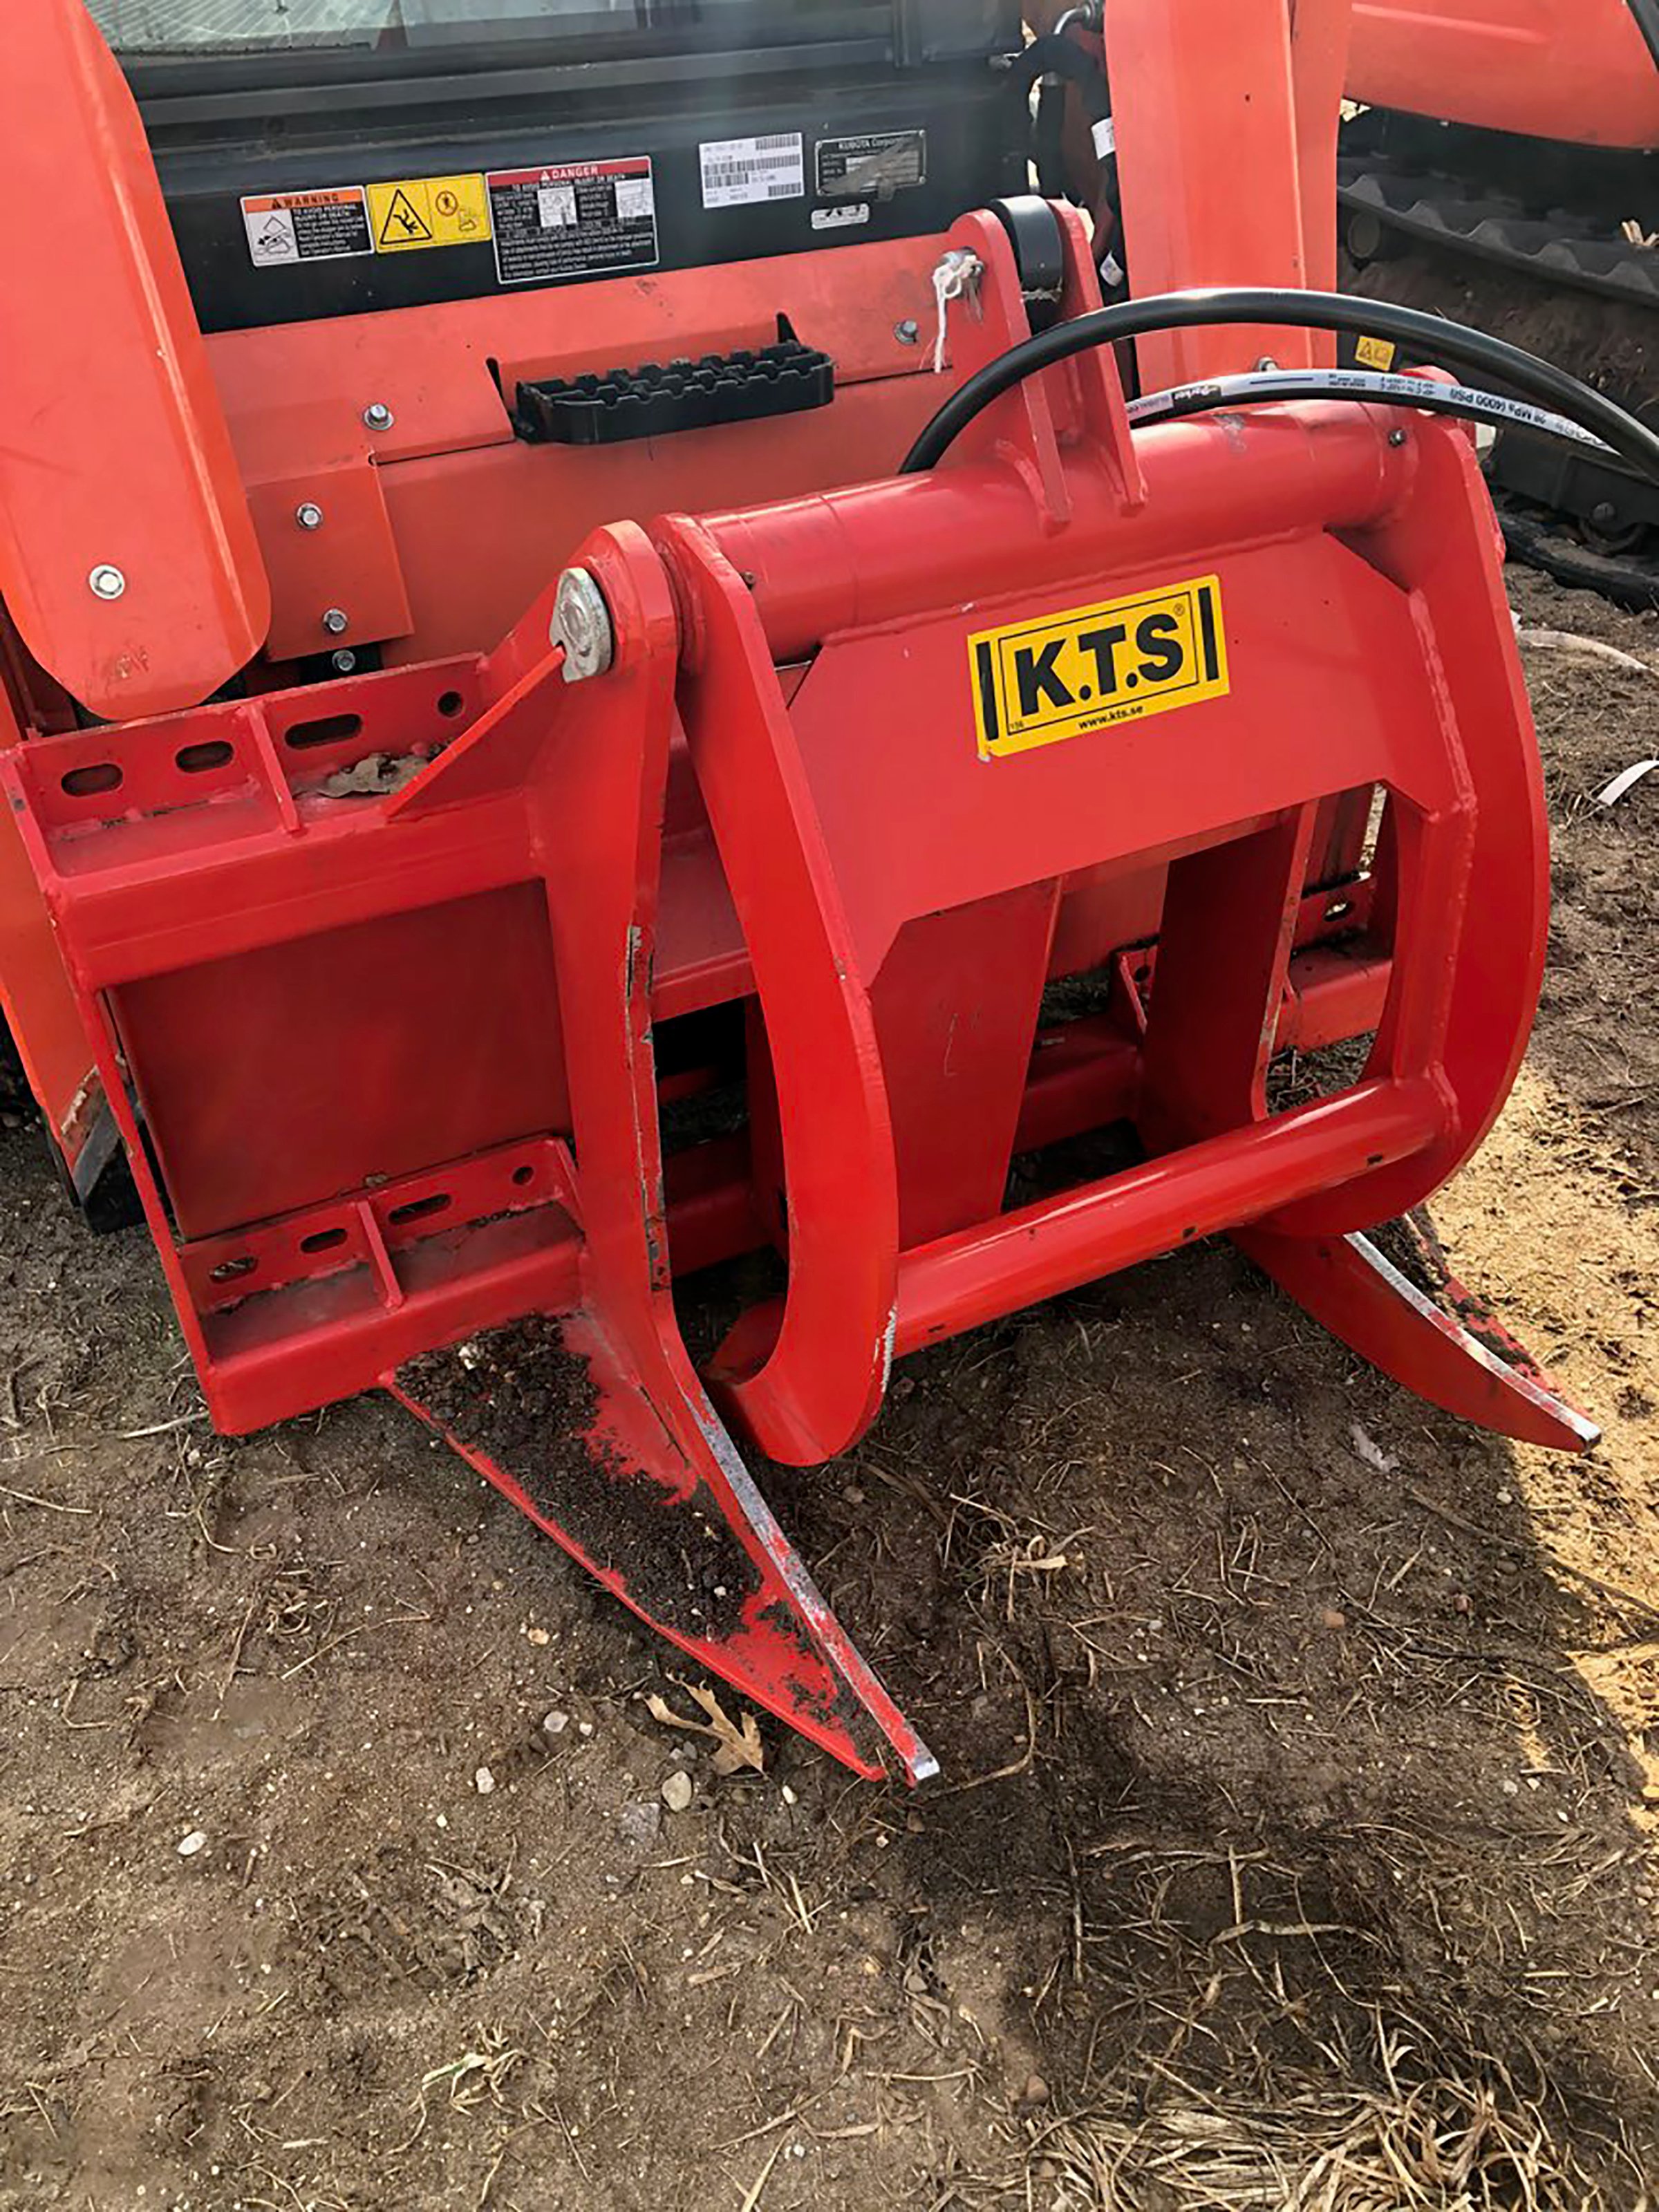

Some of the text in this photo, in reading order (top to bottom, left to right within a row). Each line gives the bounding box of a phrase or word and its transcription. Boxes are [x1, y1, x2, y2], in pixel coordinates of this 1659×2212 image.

[838, 139, 870, 150] KUBOTA
[552, 166, 599, 180] DANGER
[284, 193, 339, 207] WARNING
[1475, 394, 1506, 414] (4000
[1508, 404, 1532, 420] MPa
[1014, 613, 1184, 718] K.T.S
[1078, 704, 1144, 730] www.kts.se
